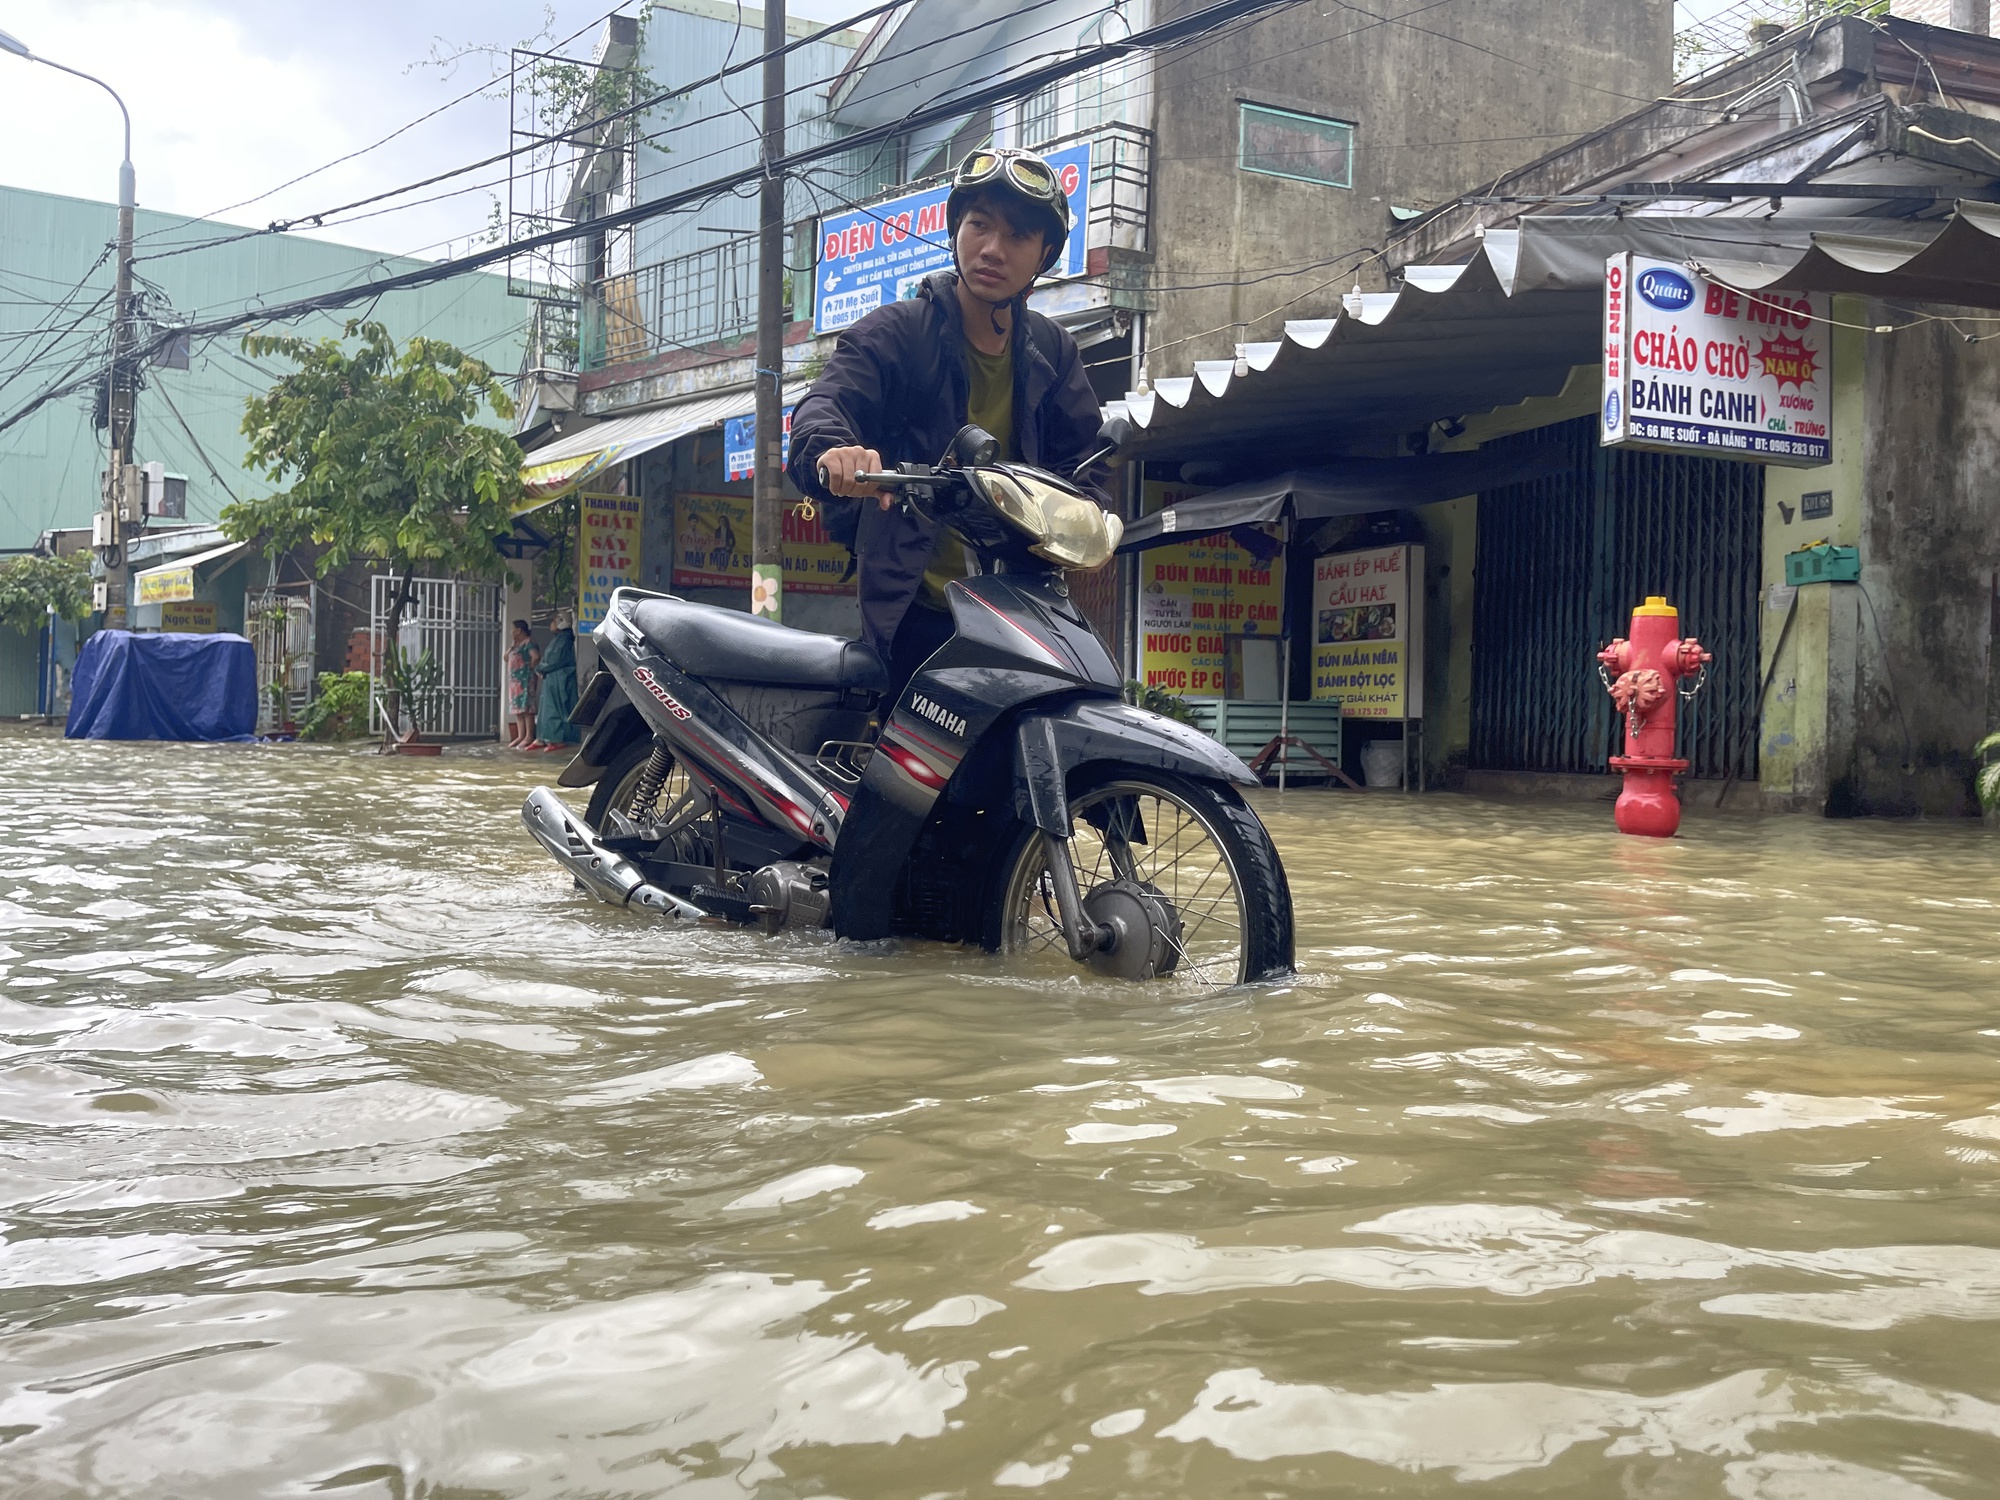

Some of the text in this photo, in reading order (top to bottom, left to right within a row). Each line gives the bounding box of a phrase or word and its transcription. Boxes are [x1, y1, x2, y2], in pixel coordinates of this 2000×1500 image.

[826, 201, 948, 262] ĐIỆN CƠ MI
[862, 259, 874, 270] MUA
[1642, 274, 1689, 301] Quán:
[834, 288, 879, 311] 70 Mẹ Suốt
[1605, 266, 1622, 334] NHỎ
[832, 312, 849, 325] 0905
[1746, 290, 1812, 331] NHỎ
[1605, 342, 1620, 378] BÉ
[1633, 324, 1750, 380] CHÁO CHỜ
[1765, 357, 1812, 379] NAM Ô
[1631, 374, 1757, 424] BÁNH CANH
[1779, 393, 1815, 411] XƯƠNG
[1767, 414, 1787, 432] CHẢ
[1794, 419, 1826, 437] TRỨNG
[1646, 424, 1659, 438] 66
[1660, 425, 1675, 443] MẸ
[1677, 425, 1700, 443] SUỐT
[1707, 429, 1721, 446] ĐÀ
[1755, 437, 1768, 451] ĐT:
[1769, 439, 1791, 454] 0905
[1791, 442, 1808, 456] 283
[1809, 444, 1825, 457] 917
[585, 497, 617, 511] THANH
[589, 552, 632, 571] HẤP
[732, 554, 740, 568] &
[795, 555, 808, 572] ÁO
[1317, 547, 1402, 581] BÁNH ÉP HUẾ
[1155, 563, 1189, 582] BÚN
[1360, 584, 1387, 602] HAI
[164, 614, 190, 626] Ngọc
[1147, 632, 1192, 653] NƯỚC
[1197, 633, 1225, 655] GIẢ
[1192, 657, 1211, 667] CÁC
[1317, 652, 1340, 668] BÚN
[1342, 647, 1370, 667] MẮM
[1148, 668, 1187, 689] NƯỚC
[1192, 668, 1207, 689] ÉP
[1317, 671, 1396, 690] BÁNH BỘT LỌC
[1369, 691, 1398, 703] KHÁT
[911, 692, 967, 737] YAMAHA
[1358, 707, 1372, 716] 175
[1373, 707, 1388, 716] 220
